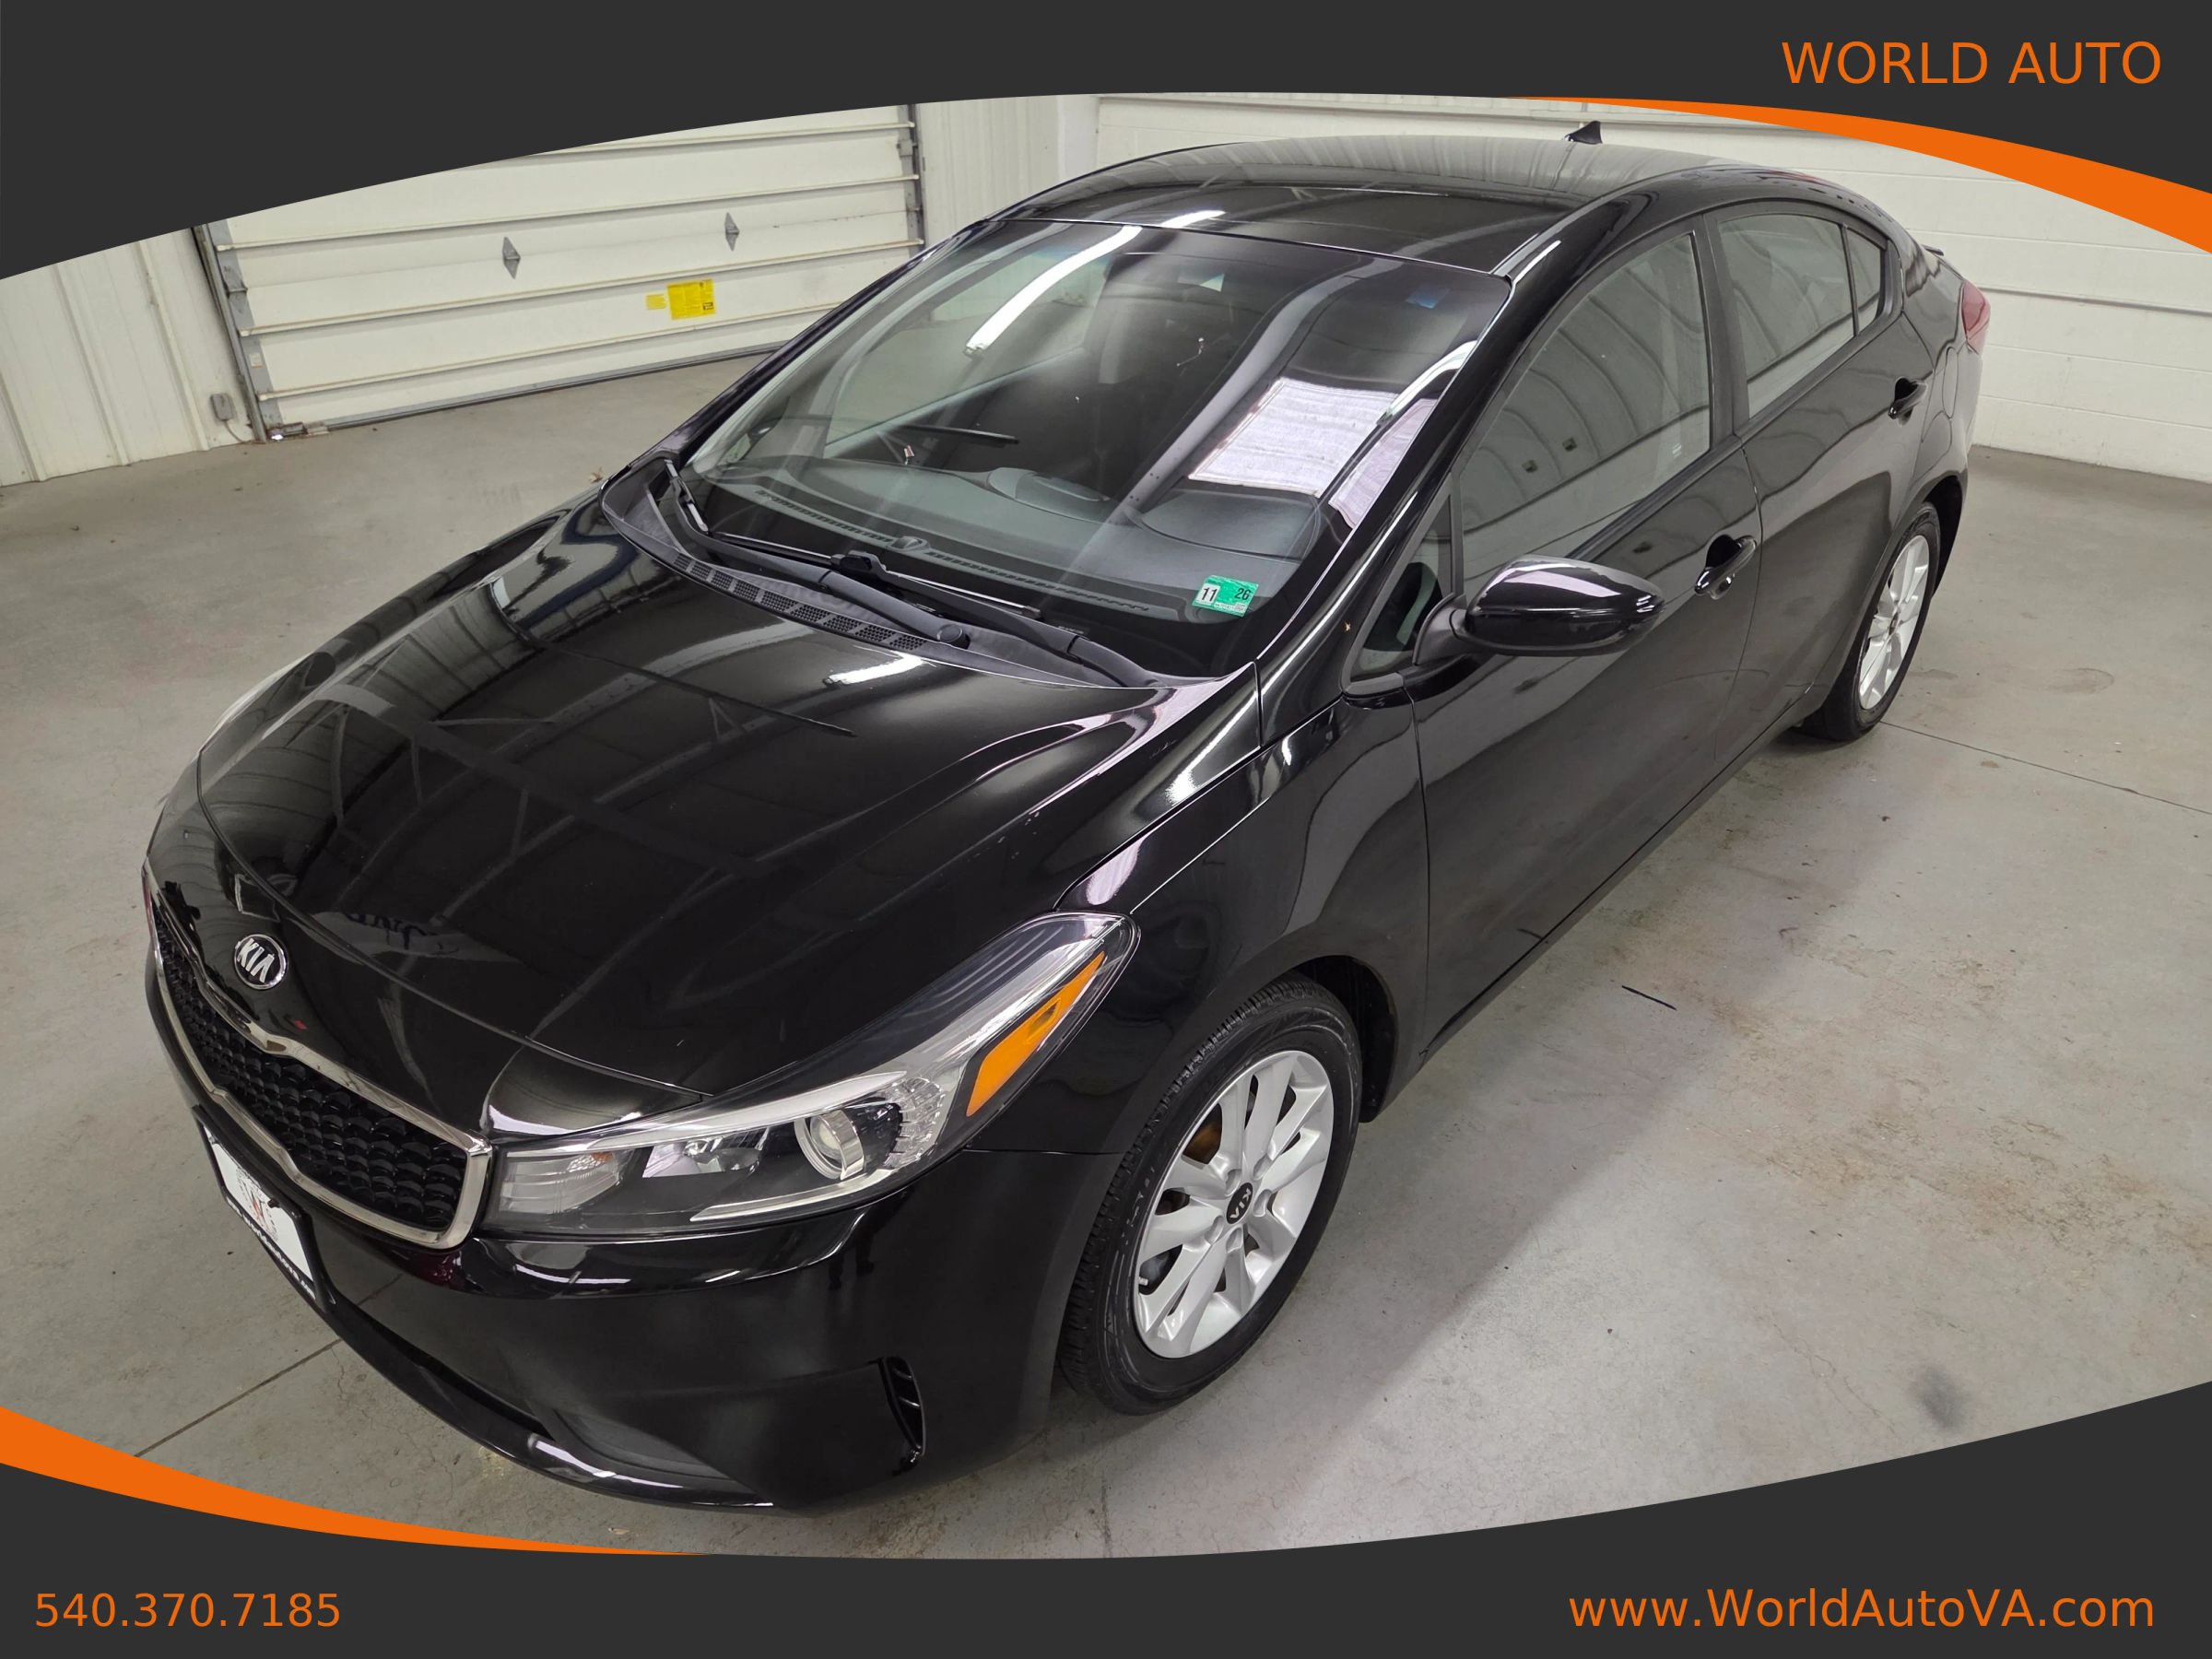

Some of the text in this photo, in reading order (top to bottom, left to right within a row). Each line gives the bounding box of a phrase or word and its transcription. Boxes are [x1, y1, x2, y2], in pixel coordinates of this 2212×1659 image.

[1201, 587, 1252, 602] 11 26
[237, 937, 275, 983] KIA
[1230, 1187, 1252, 1218] KIA
